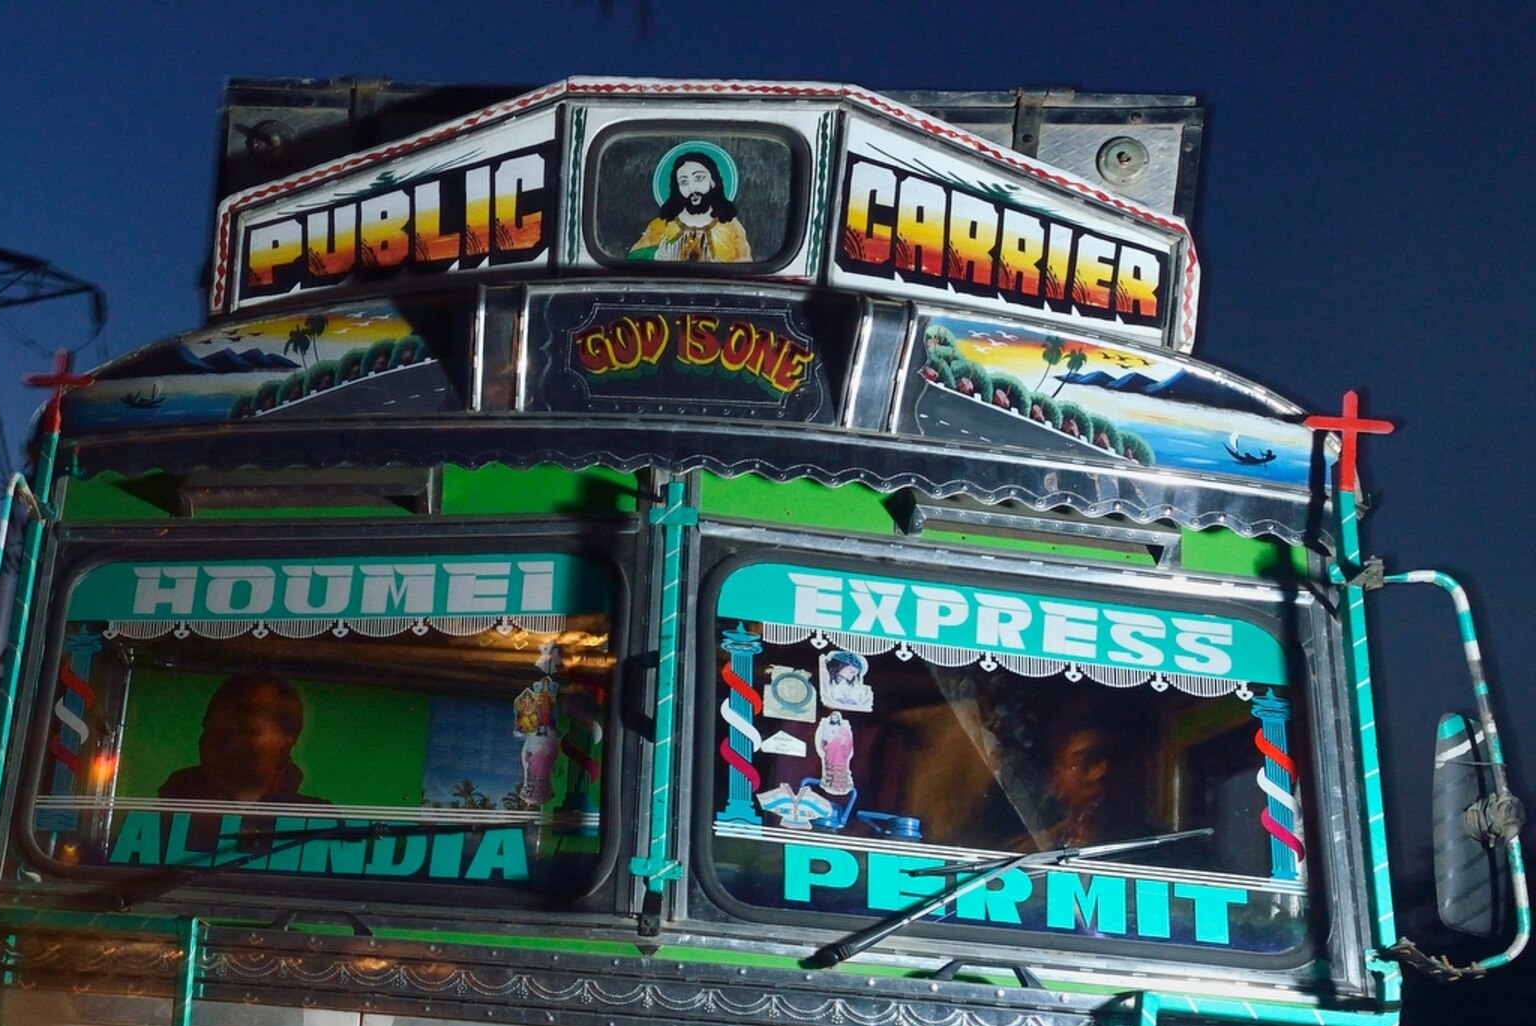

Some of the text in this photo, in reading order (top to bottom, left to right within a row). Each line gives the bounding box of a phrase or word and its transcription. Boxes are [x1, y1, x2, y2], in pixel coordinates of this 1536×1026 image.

[248, 152, 1161, 319] PUBLIC CARRIER
[576, 314, 814, 398] GOD IS ONE
[133, 561, 1233, 675] HOUMEI EXPRESS
[109, 811, 1248, 945] ALL INDIA PERMIT
